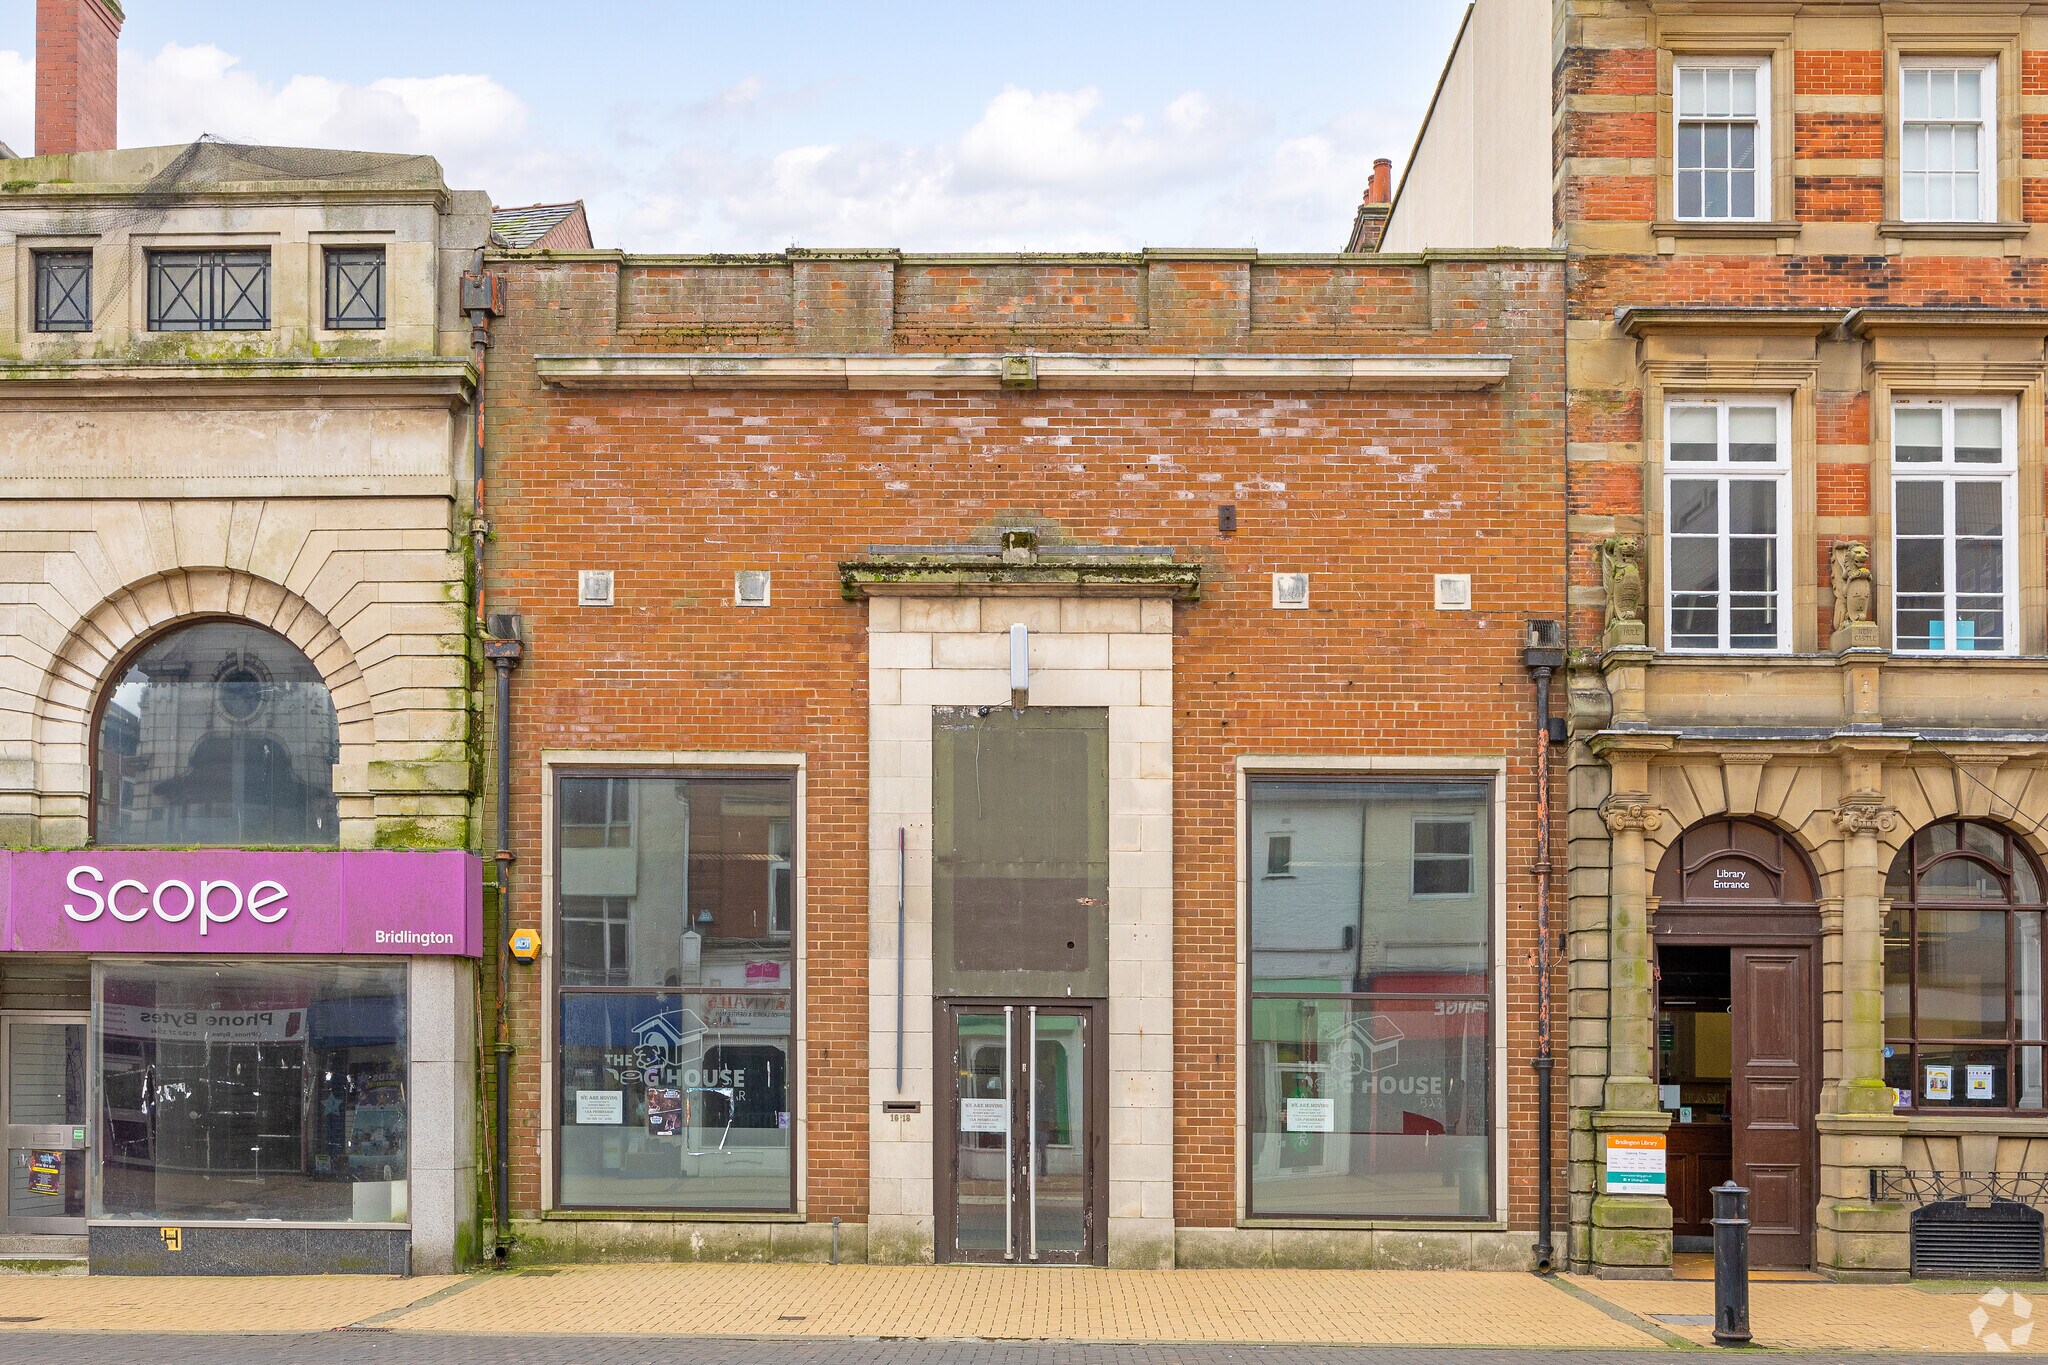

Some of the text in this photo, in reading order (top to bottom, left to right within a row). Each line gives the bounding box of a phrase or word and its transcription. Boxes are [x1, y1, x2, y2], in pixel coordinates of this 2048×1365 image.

[1716, 869, 1747, 880] Library
[1713, 879, 1750, 889] Entrance
[64, 865, 289, 936] Scope
[375, 930, 454, 947] Bridlington
[515, 938, 531, 948] ADT
[604, 1054, 632, 1066] THE
[666, 1069, 745, 1087] HOUSE
[1362, 1076, 1441, 1095] HOUSE
